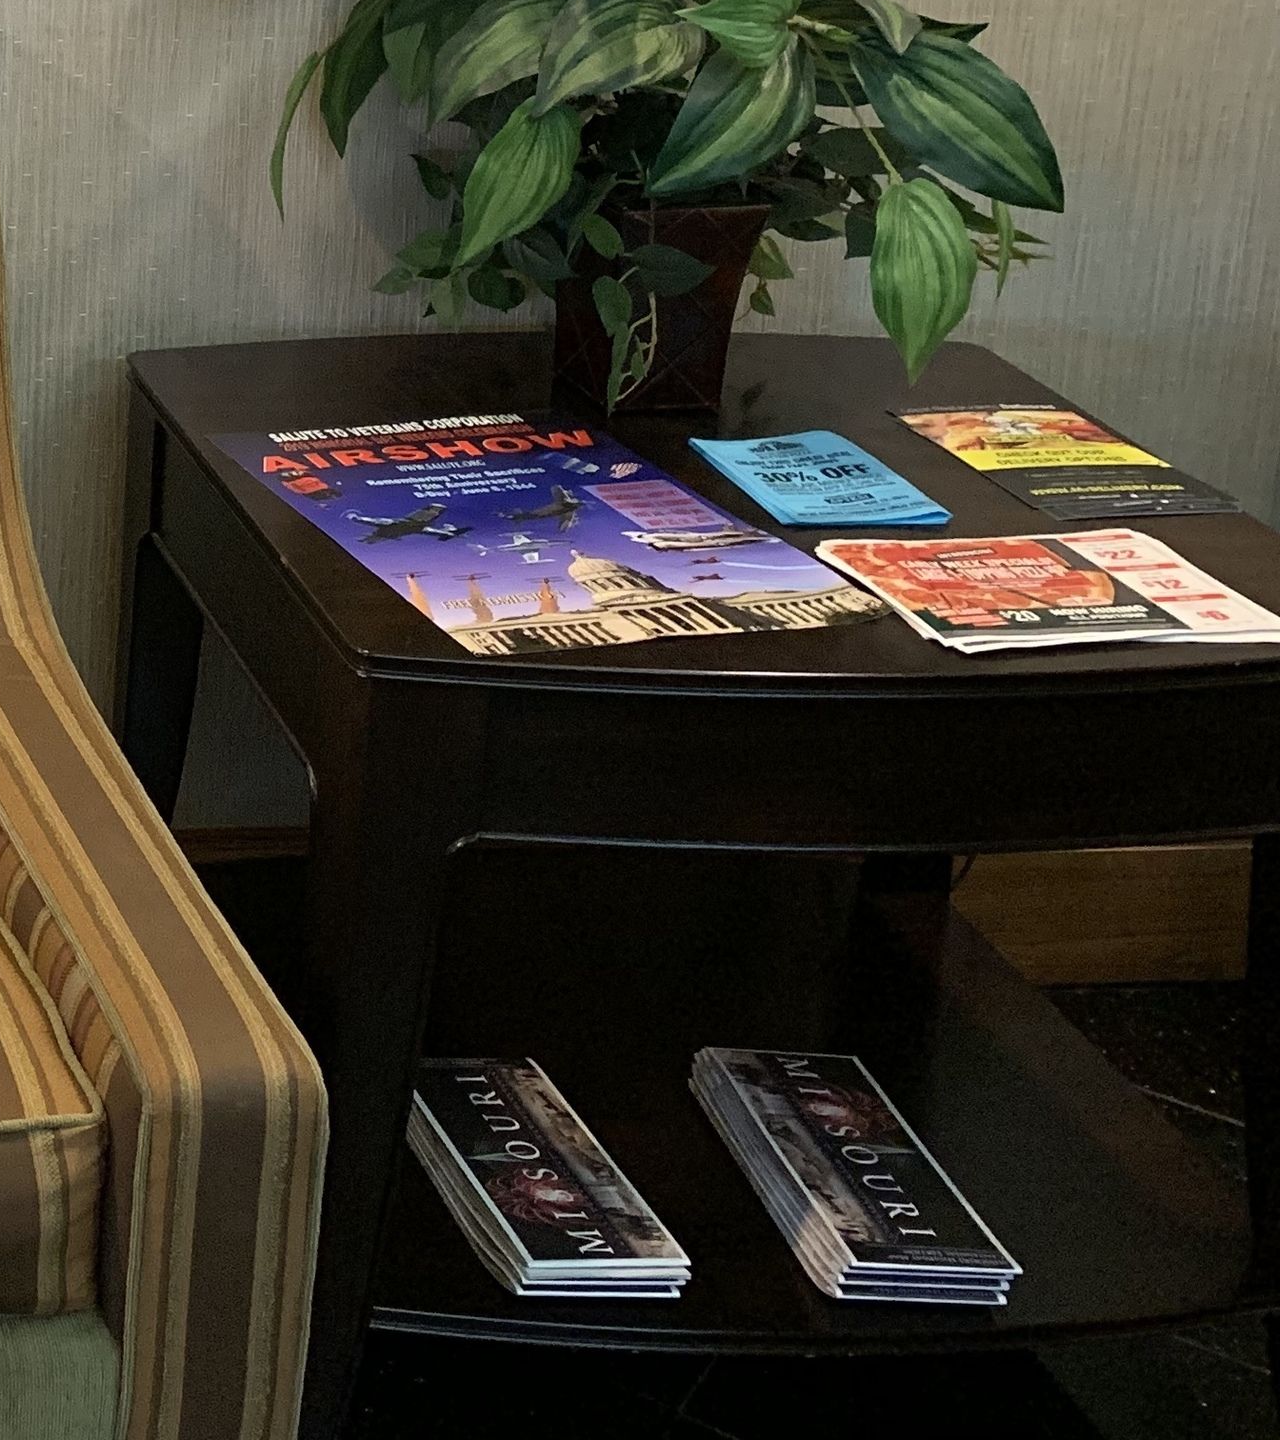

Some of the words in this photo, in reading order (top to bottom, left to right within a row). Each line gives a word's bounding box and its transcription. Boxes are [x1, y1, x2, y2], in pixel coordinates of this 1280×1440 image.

[268, 429, 328, 443] SALUTE
[324, 427, 349, 438] TO
[346, 421, 424, 437] VETERANS
[422, 413, 525, 430] CORPORATION
[263, 429, 594, 474] AIRSHOW
[366, 475, 450, 486] Remembering
[449, 472, 483, 480] Their
[484, 467, 546, 477] Sacrifices
[753, 471, 818, 483] 30%
[819, 463, 873, 479] OFF
[413, 483, 444, 491] 75th
[445, 477, 517, 489] Anniversary
[413, 490, 451, 499] D-Day
[1093, 549, 1142, 560] $22
[1140, 578, 1189, 590] $12
[999, 610, 1041, 622] $20
[1048, 608, 1090, 616] NOW
[1089, 605, 1149, 614] HIRING
[776, 1057, 937, 1237] MISSOURI
[454, 1074, 615, 1255] MISSOURI
